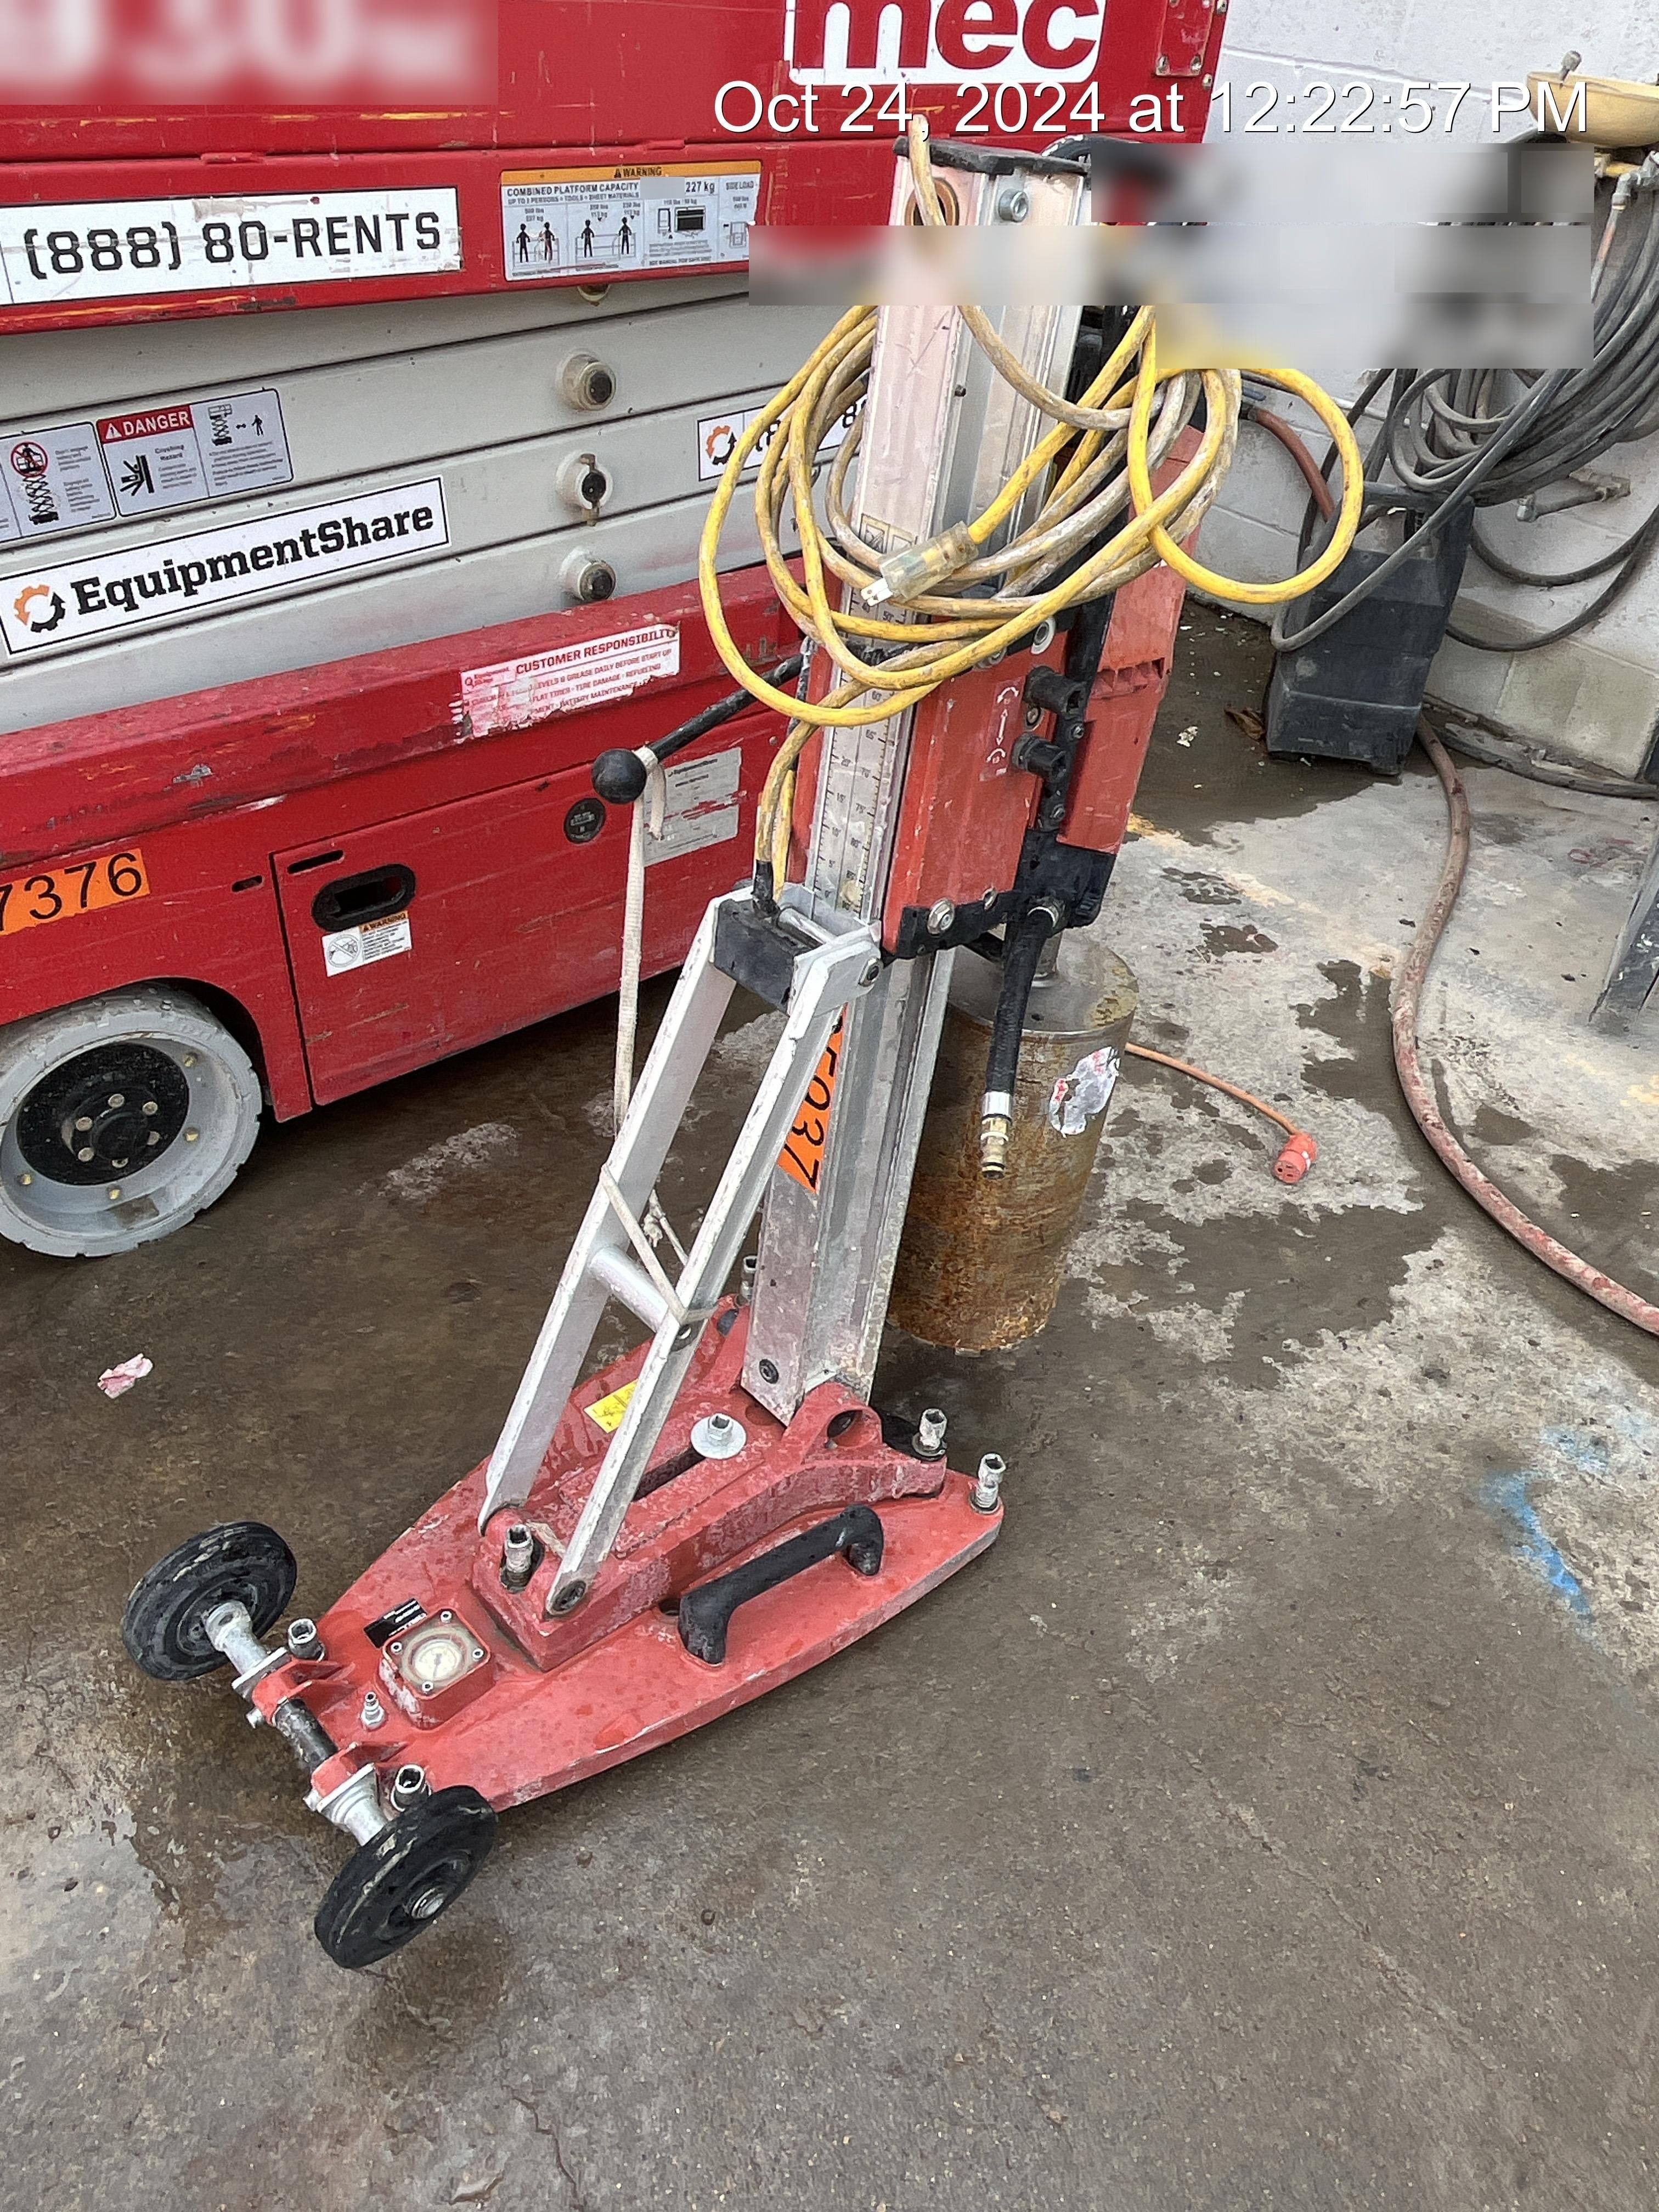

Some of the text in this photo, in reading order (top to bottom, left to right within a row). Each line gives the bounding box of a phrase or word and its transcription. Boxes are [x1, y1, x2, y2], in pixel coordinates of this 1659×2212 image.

[793, 0, 1099, 70] mec
[507, 179, 715, 197] COMBINED PLATFORM CAPACITY 227 kg
[623, 167, 662, 177] WARNING
[23, 212, 440, 280] (888) 80-RENTS
[123, 410, 191, 436] DANGER
[70, 505, 434, 613] EquipmentShare
[516, 650, 581, 675] CUSTOMER
[595, 663, 614, 675] DAILY
[0, 853, 142, 932] 7376
[783, 1017, 844, 1189] 037
